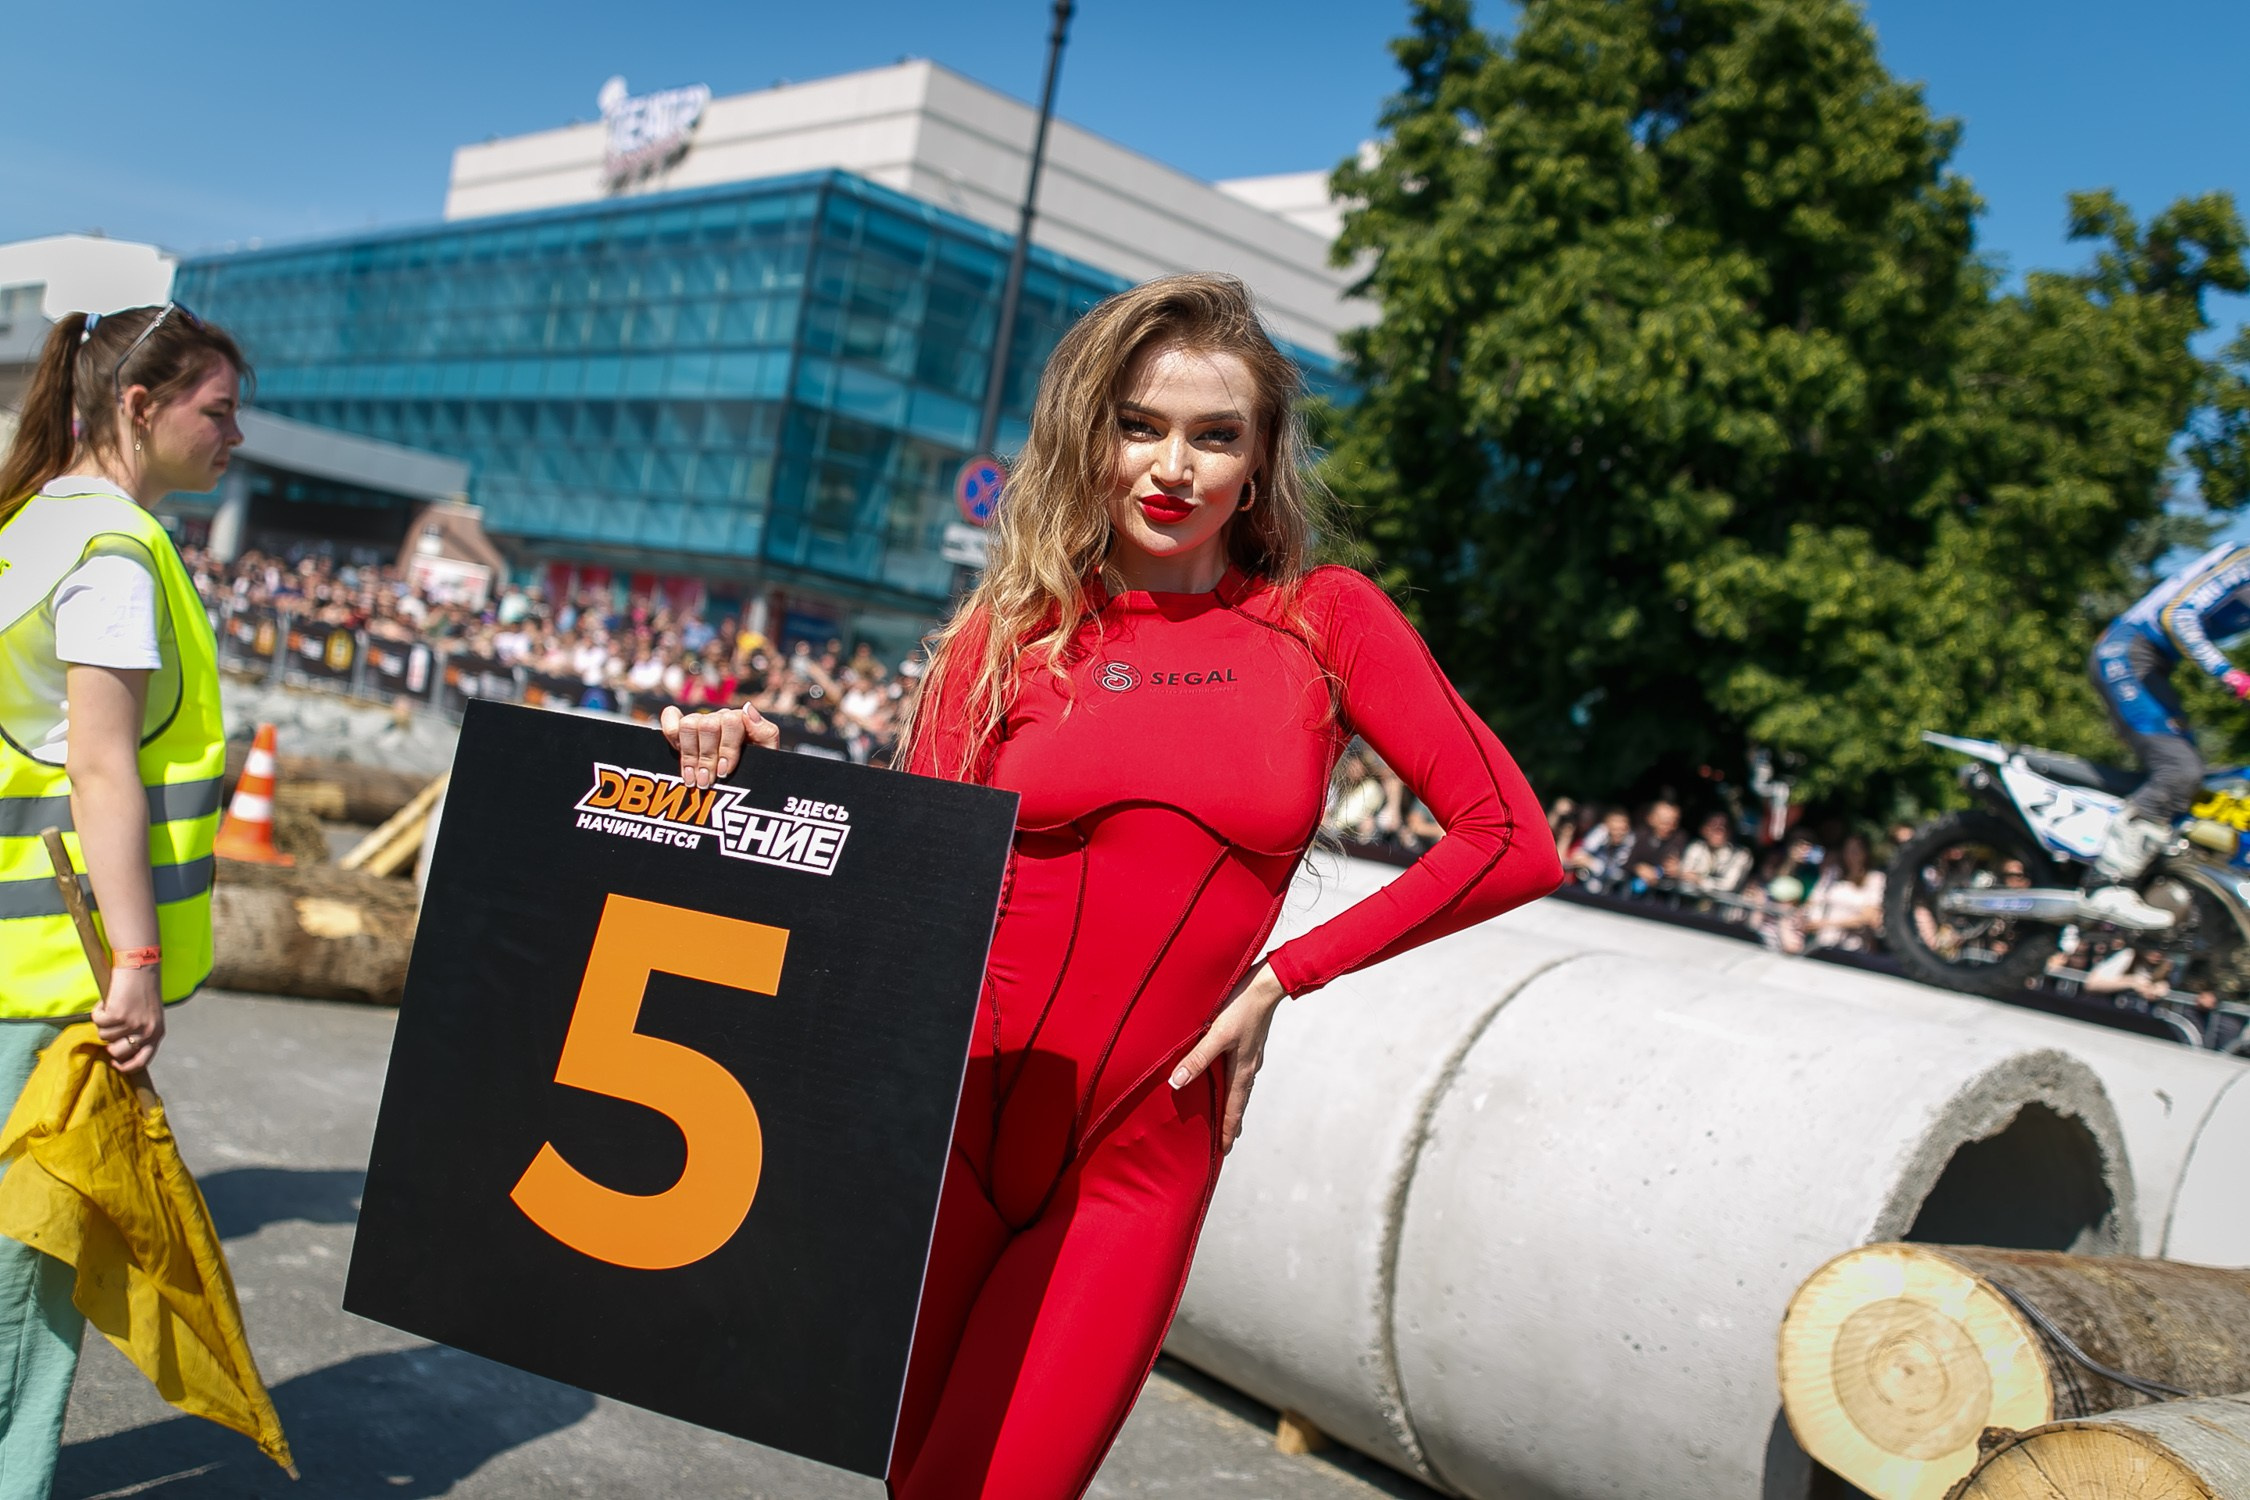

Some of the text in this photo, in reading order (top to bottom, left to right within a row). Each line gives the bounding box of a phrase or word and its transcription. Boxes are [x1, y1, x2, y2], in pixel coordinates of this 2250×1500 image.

[1150, 668, 1238, 686] SEGAL
[784, 796, 850, 822] ЗДЕСЬ
[575, 813, 702, 850] НАЧИНАЕТСЯ
[510, 894, 788, 1269] 5
